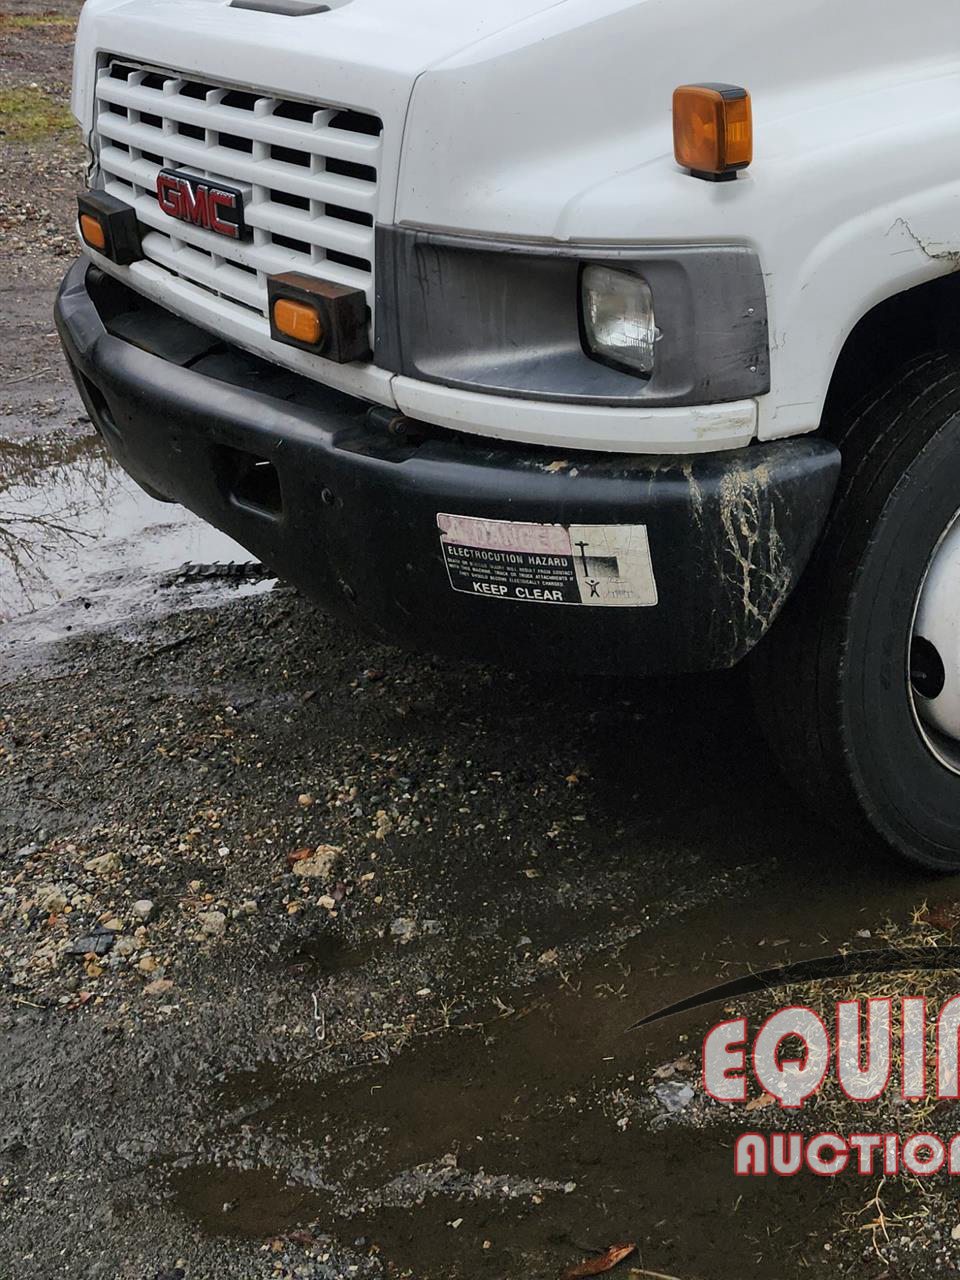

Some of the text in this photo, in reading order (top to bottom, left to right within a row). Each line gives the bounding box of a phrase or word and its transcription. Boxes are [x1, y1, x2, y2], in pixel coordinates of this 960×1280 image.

[156, 172, 239, 238] GMC
[447, 545, 568, 567] ELECTROCUTION HAZARD
[472, 581, 563, 601] KEEP CLEAR
